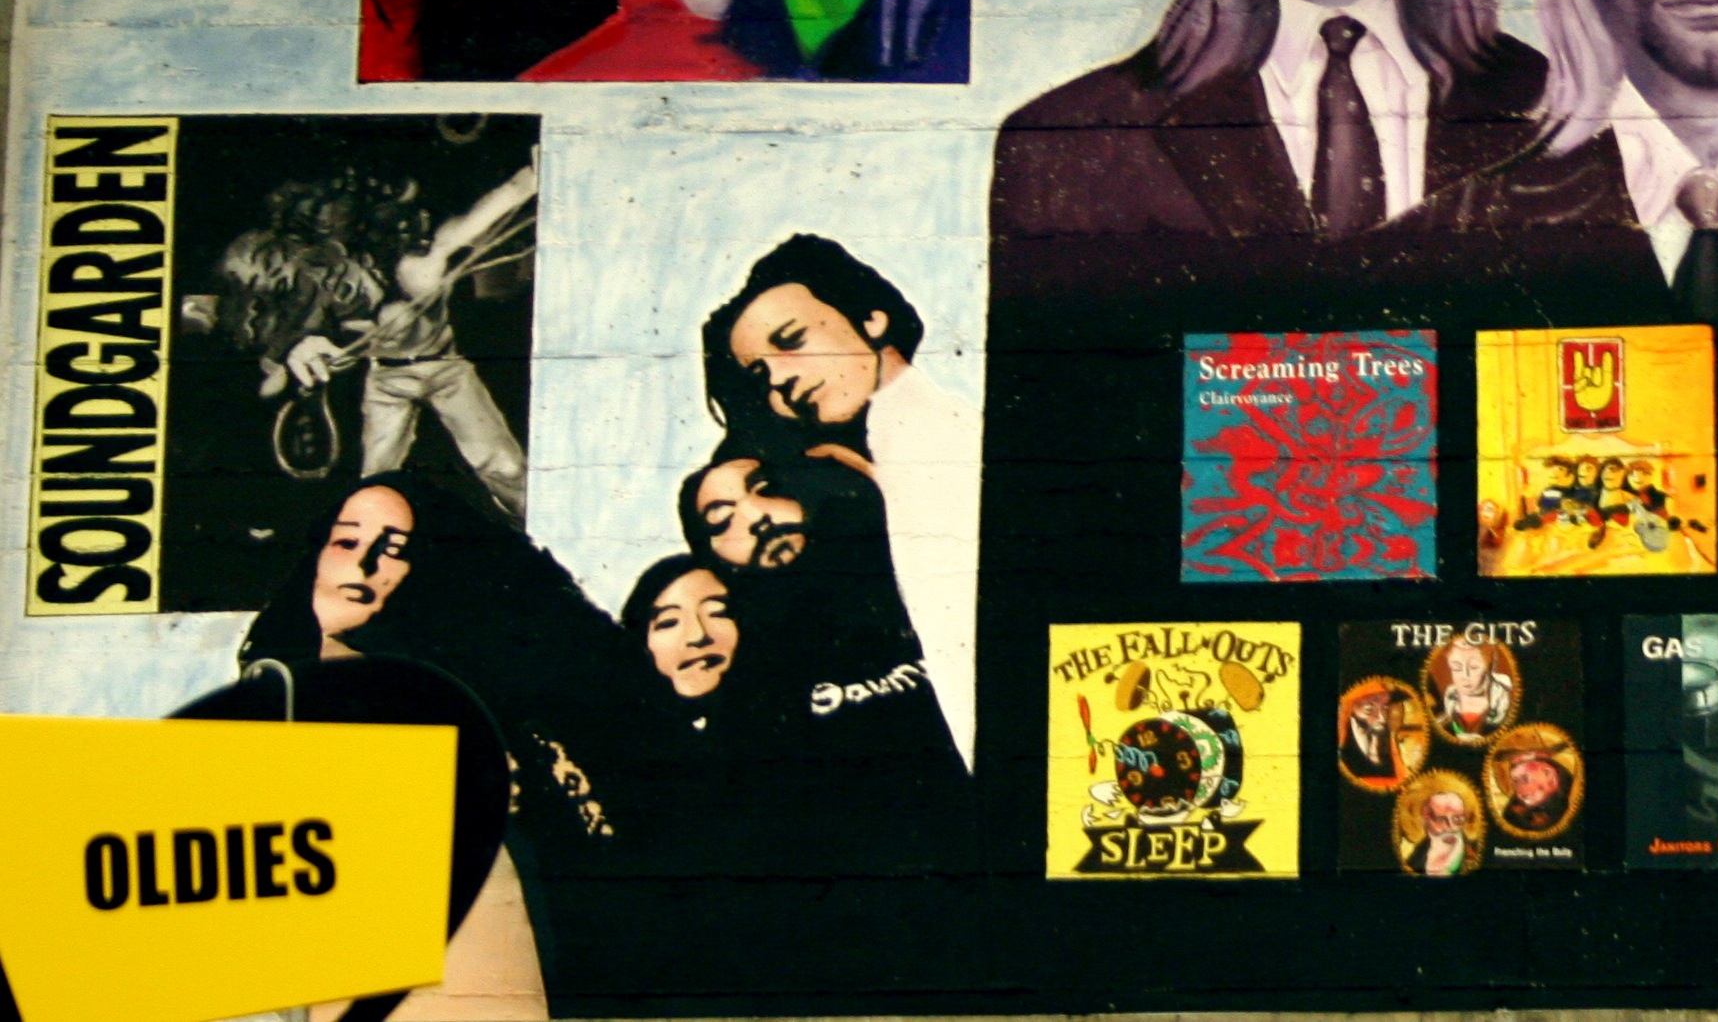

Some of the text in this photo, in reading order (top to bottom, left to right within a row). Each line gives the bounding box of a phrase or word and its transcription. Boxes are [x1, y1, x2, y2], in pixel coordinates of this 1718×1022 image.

[36, 125, 169, 604] SOUNDGARDEN
[1199, 351, 1424, 383] Screaming Trees
[1390, 620, 1537, 647] THE GITS
[1641, 635, 1704, 660] GAS
[1053, 643, 1113, 683] THE
[85, 818, 335, 911] OLDIES
[1100, 826, 1228, 871] SLEEP
